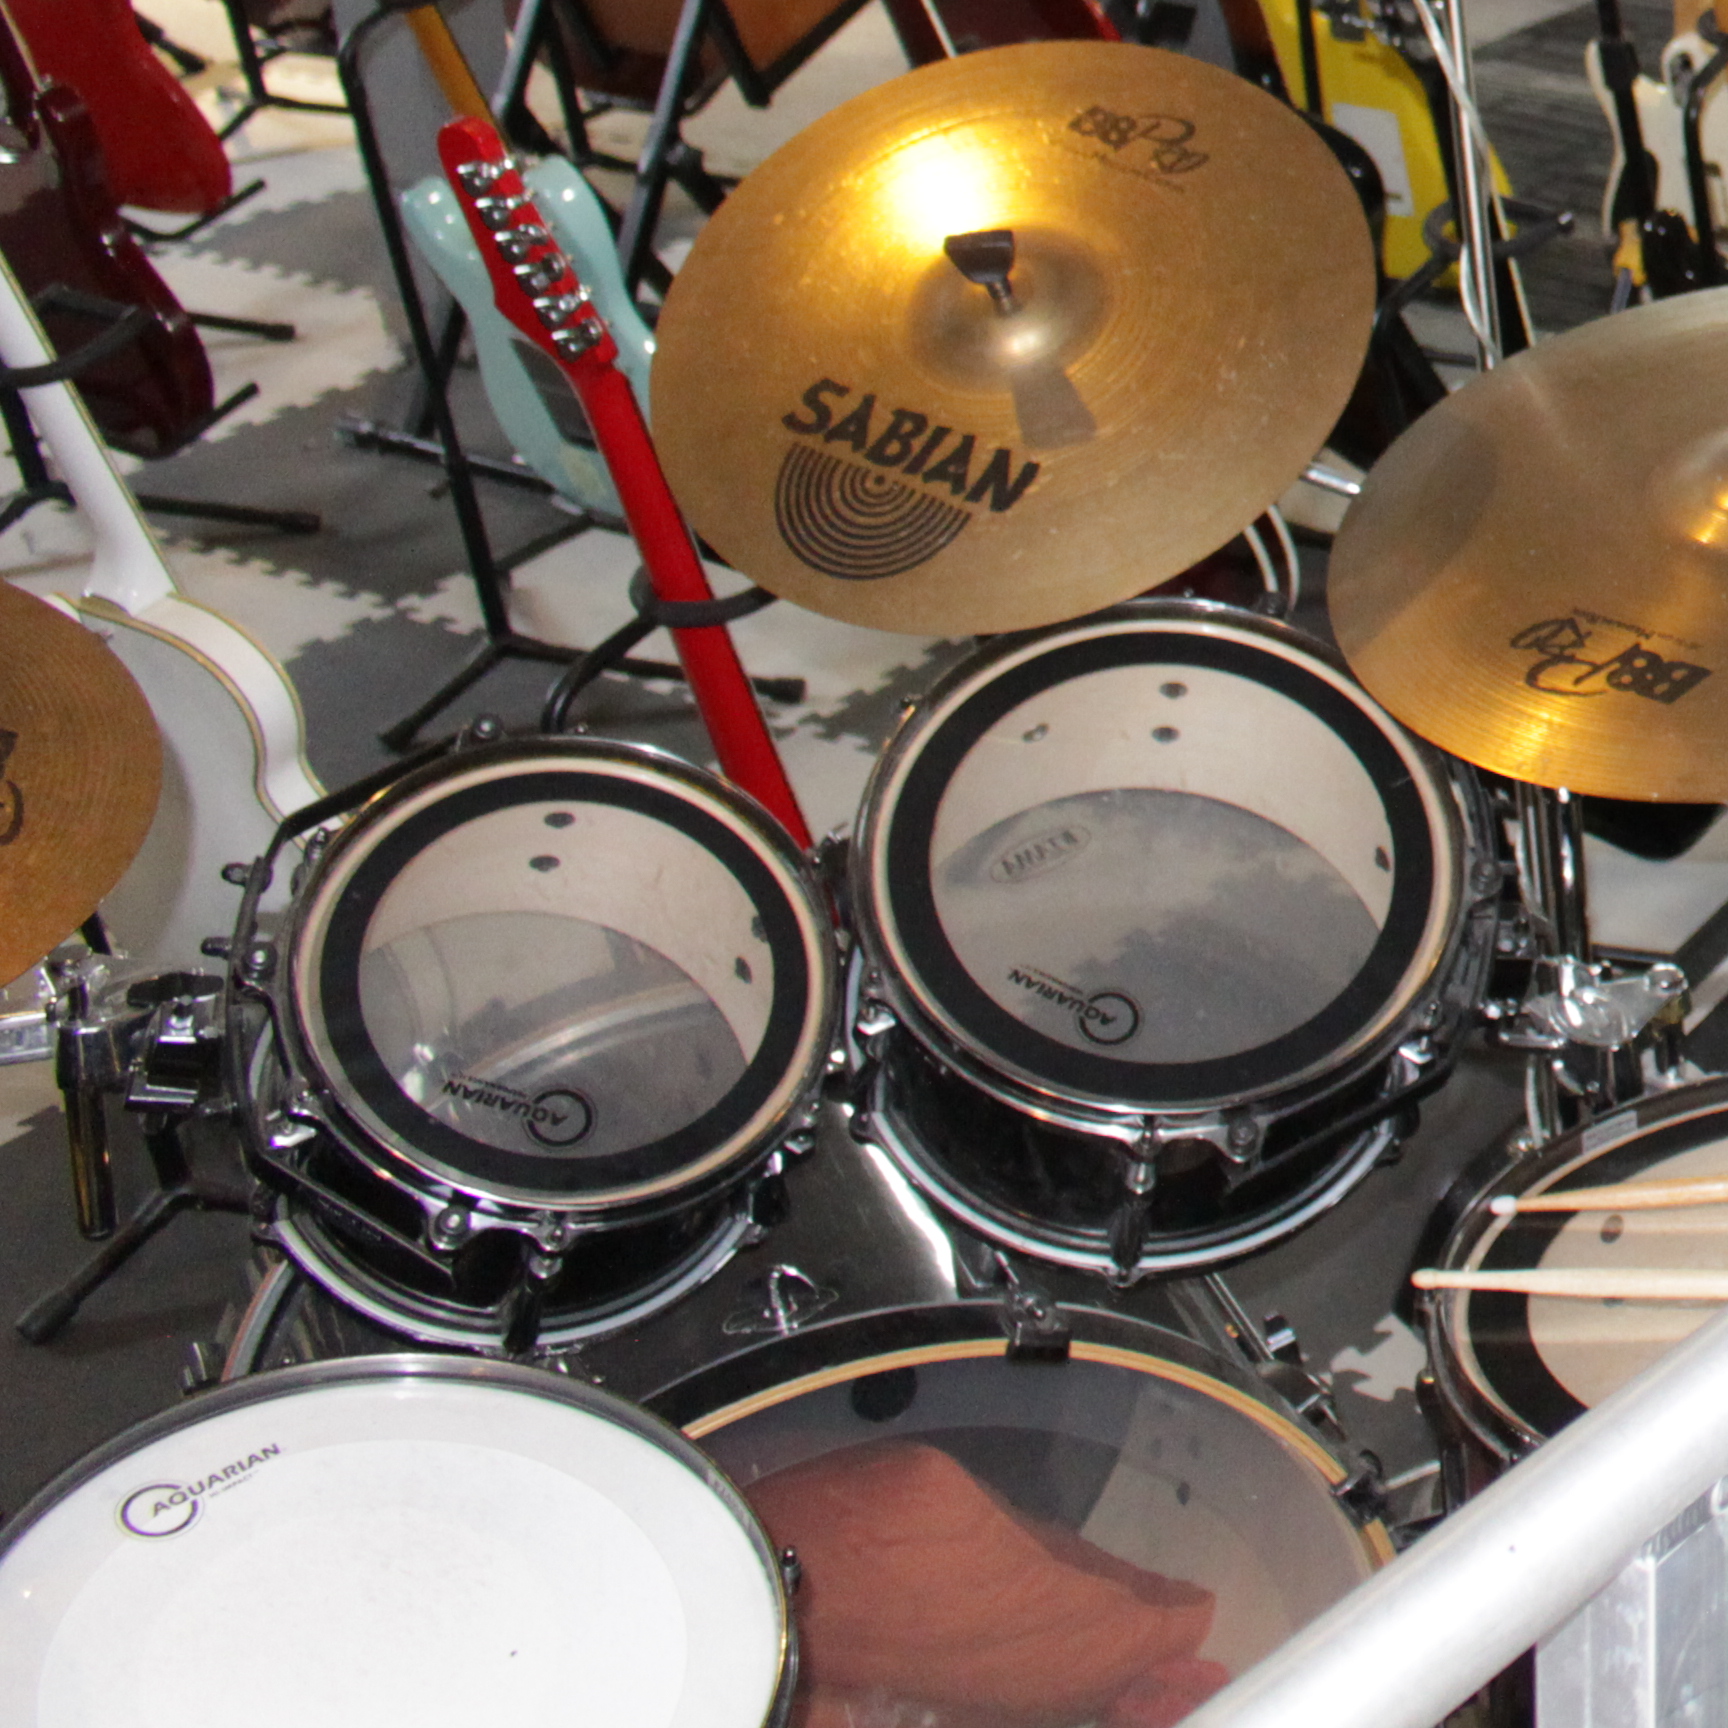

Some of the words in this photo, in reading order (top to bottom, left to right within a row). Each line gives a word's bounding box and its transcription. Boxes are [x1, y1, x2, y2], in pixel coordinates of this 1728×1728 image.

[781, 376, 1042, 514] SABIAN
[1007, 968, 1117, 1027] AQUARIAN
[441, 1079, 569, 1127] AQUARIAN
[152, 1442, 282, 1518] AQUARIAN
